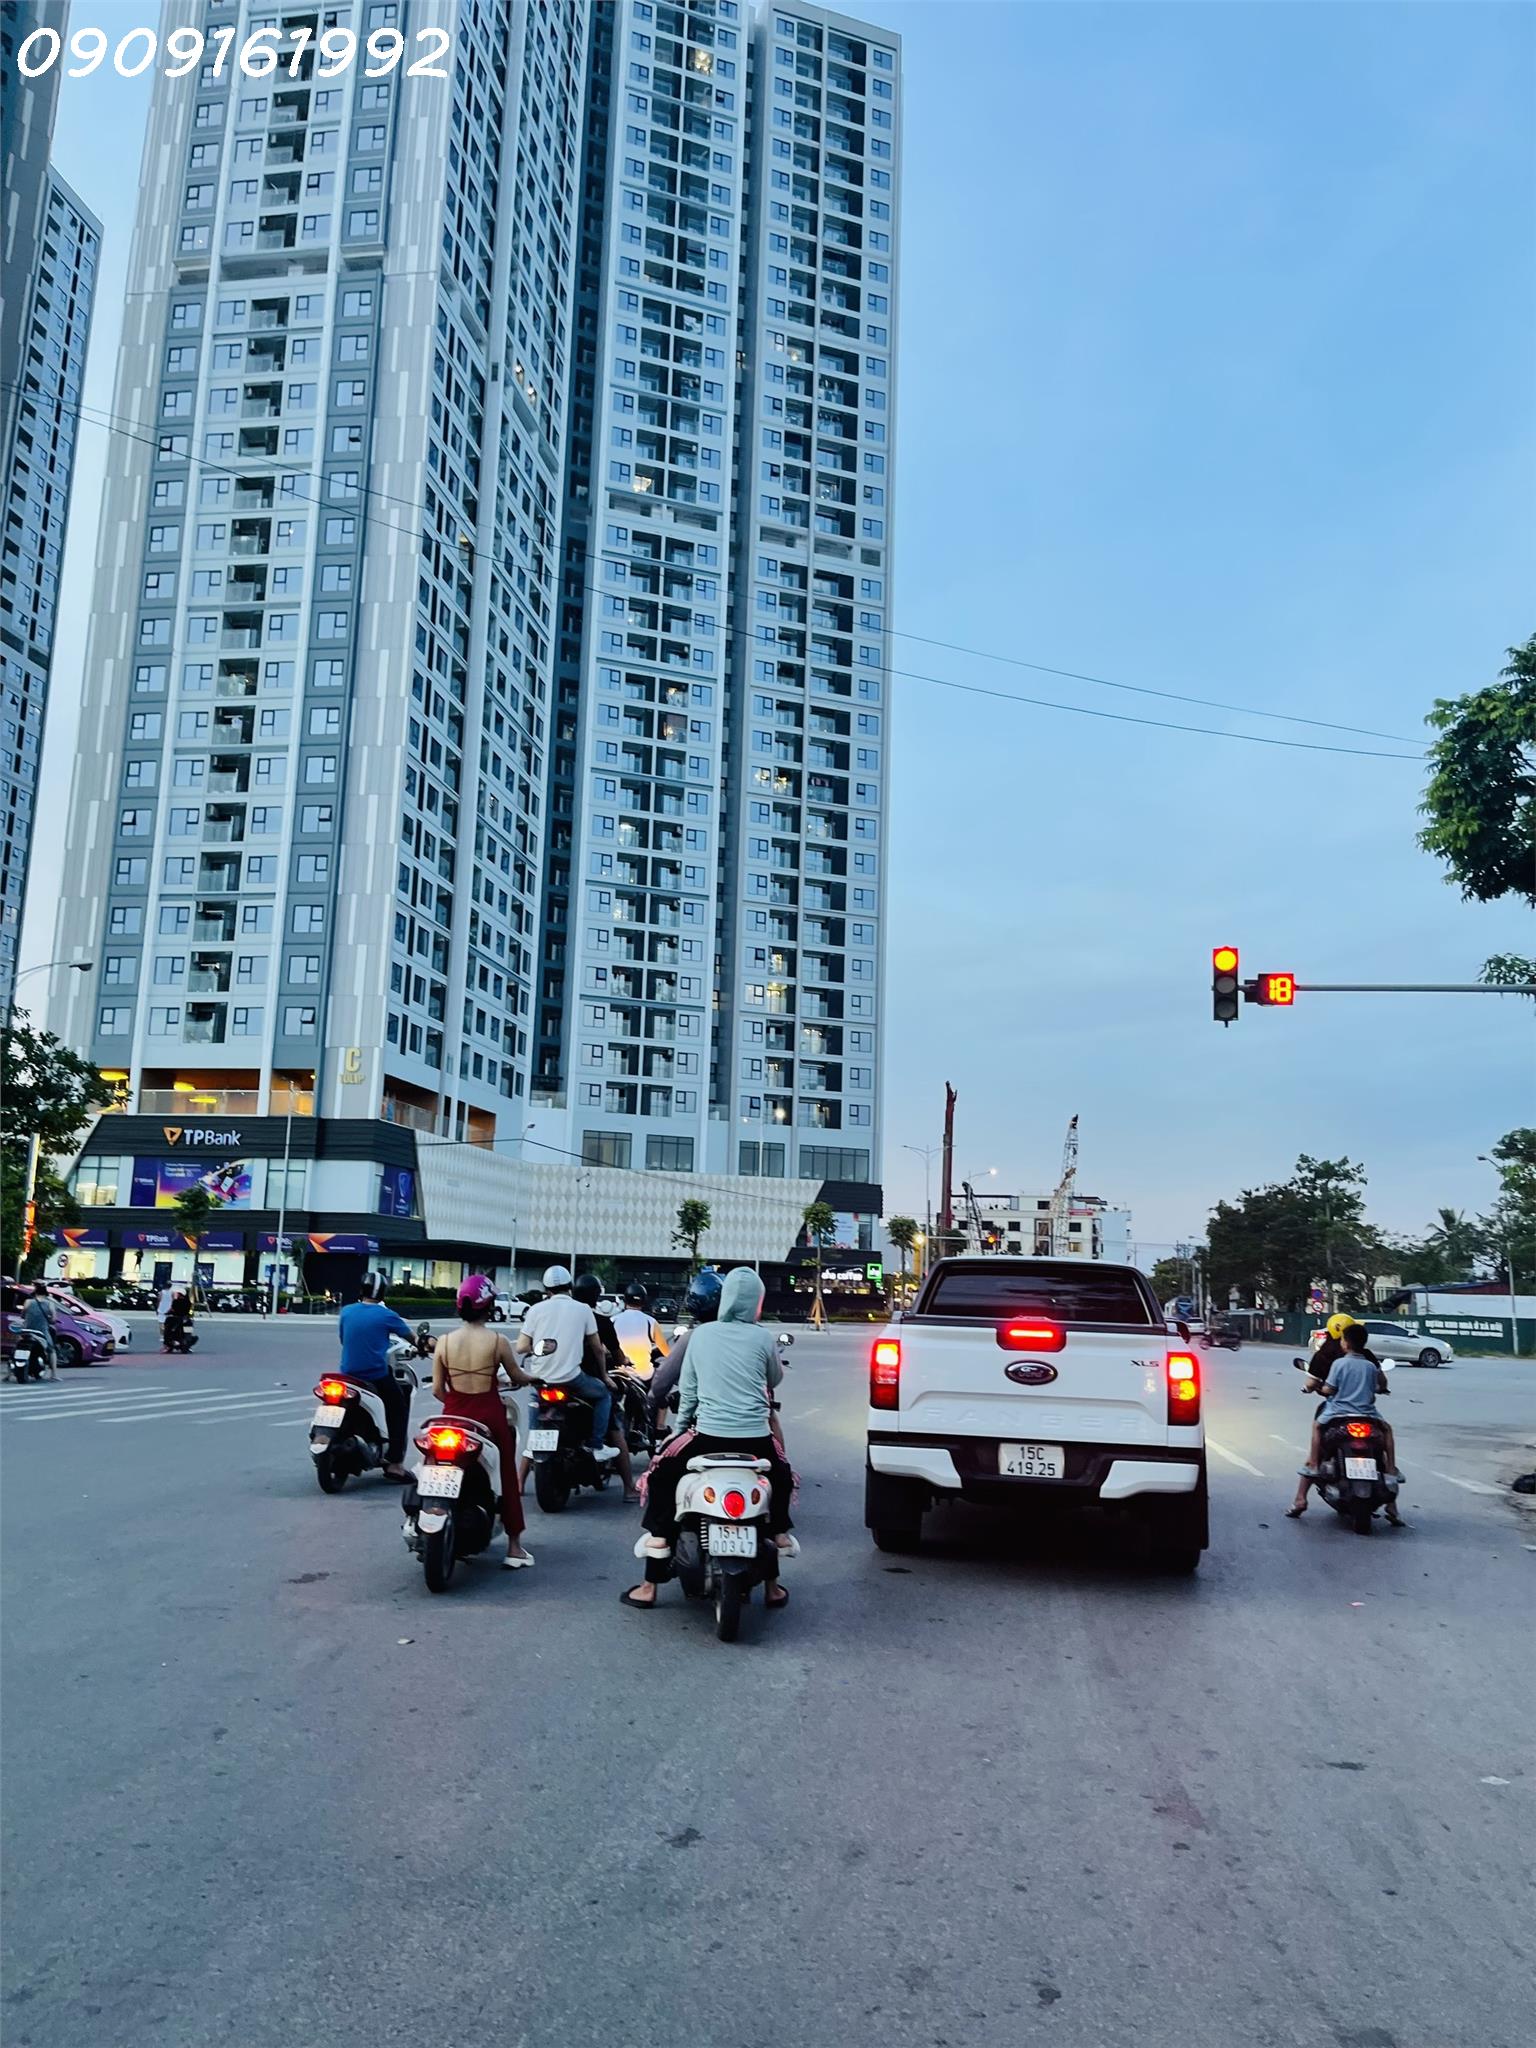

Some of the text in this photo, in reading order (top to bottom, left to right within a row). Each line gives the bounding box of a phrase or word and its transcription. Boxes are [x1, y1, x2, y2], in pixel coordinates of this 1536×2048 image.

[1269, 977, 1292, 1002] 18
[345, 1047, 361, 1072] C
[183, 1129, 242, 1146] TPBank
[1130, 1359, 1159, 1367] XLS
[1020, 1446, 1045, 1461] 15C
[1007, 1461, 1056, 1477] 419.25
[718, 1526, 749, 1540] 15-L1
